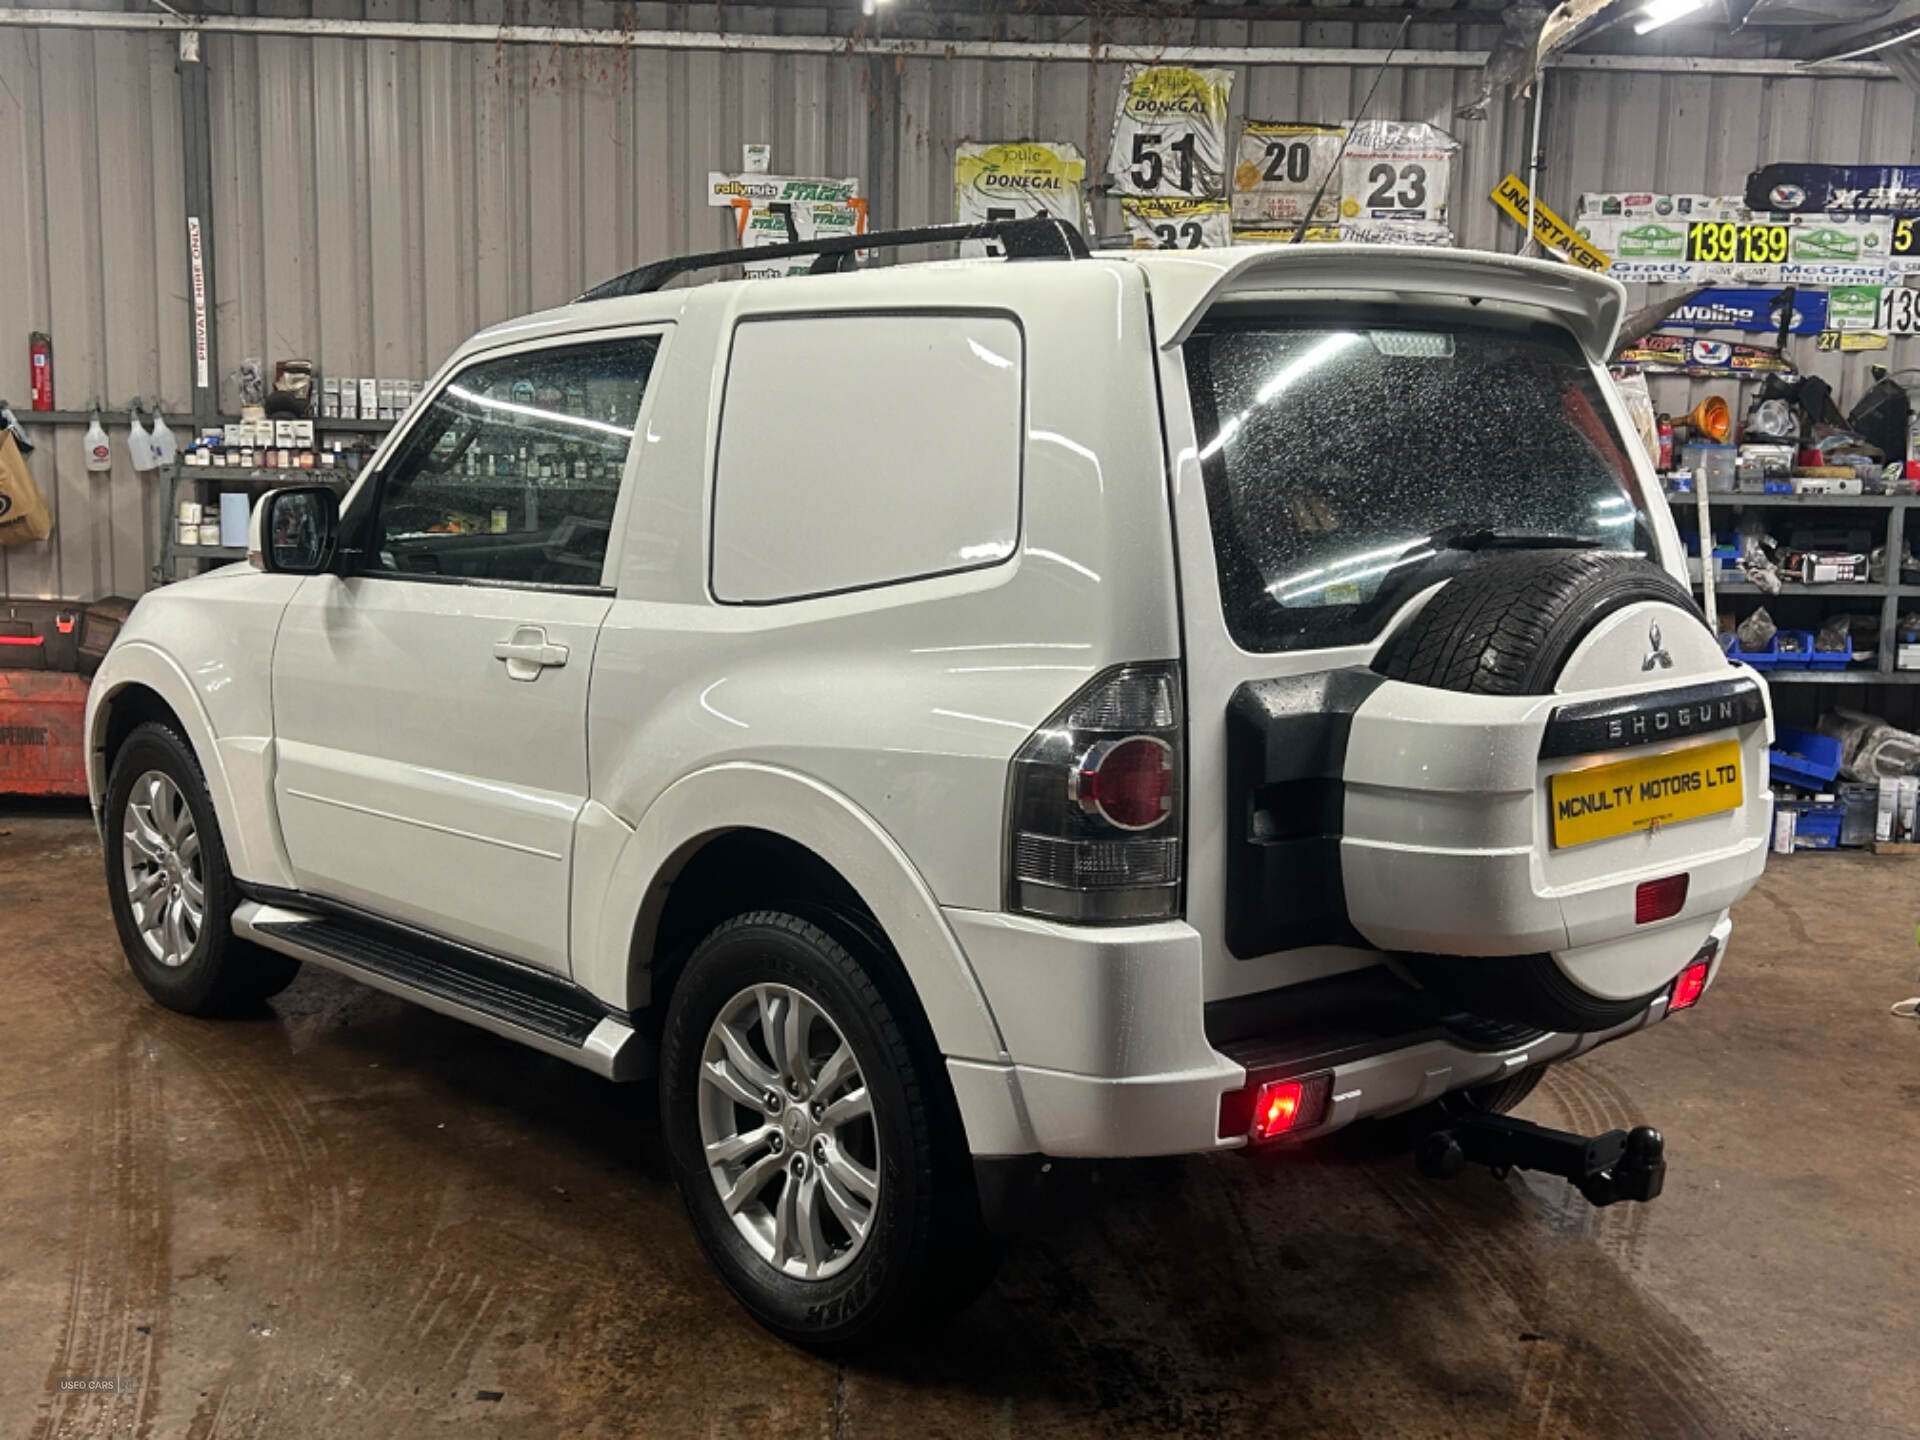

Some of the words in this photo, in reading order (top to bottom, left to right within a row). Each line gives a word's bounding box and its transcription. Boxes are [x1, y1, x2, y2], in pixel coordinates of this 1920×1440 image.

[1131, 133, 1195, 191] 51
[1262, 142, 1311, 183] 20
[985, 174, 1062, 190] DONEGAL
[1366, 163, 1426, 208] 23
[1154, 221, 1204, 249] 32
[1689, 222, 1736, 262] 139
[1740, 224, 1788, 263] 139
[1894, 218, 1913, 251] 5
[1611, 263, 1692, 275] Grady
[1818, 332, 1839, 350] 27
[1608, 701, 1733, 738] SHOGUN
[1558, 786, 1633, 821] MCNULTY
[1640, 771, 1701, 802] MOTORS
[1706, 765, 1736, 787] LTD
